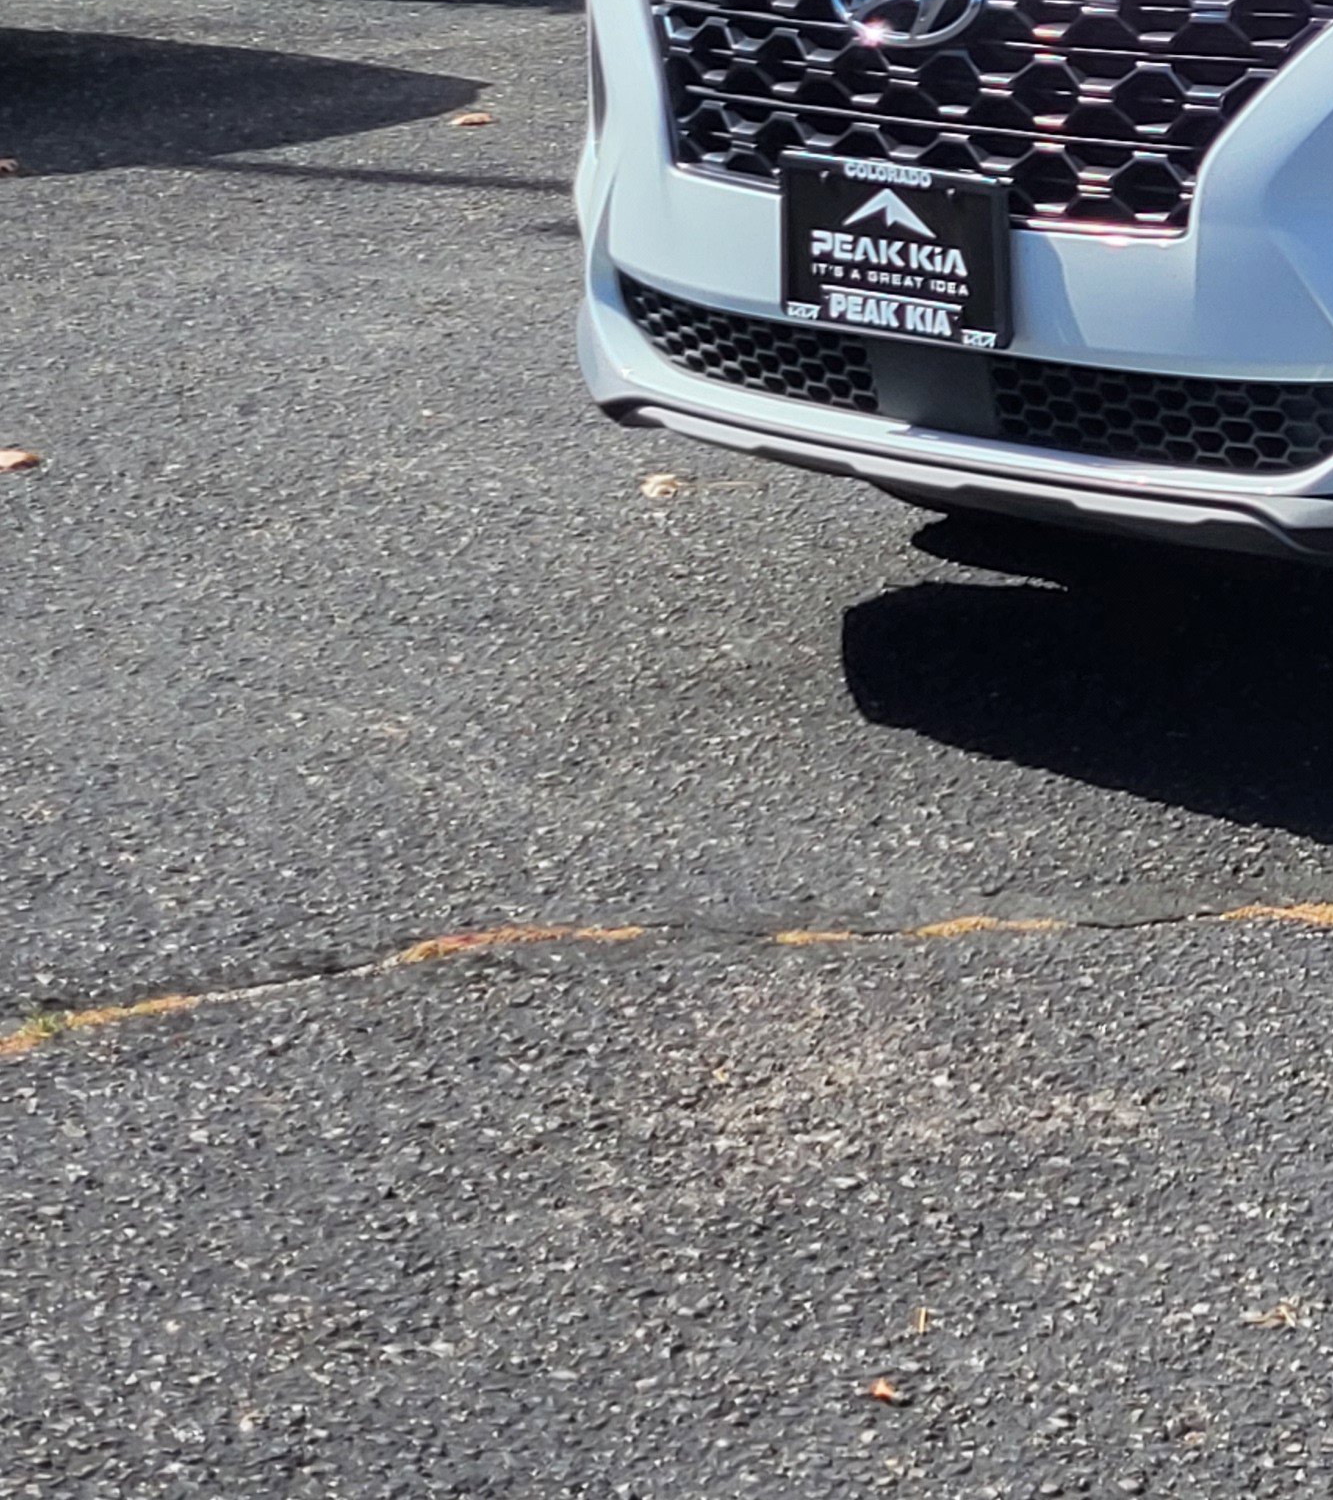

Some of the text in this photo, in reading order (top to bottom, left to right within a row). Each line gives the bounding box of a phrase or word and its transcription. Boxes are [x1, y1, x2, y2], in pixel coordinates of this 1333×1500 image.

[843, 161, 933, 188] COLORADO
[811, 229, 906, 268] PEAK
[811, 262, 970, 296] IT'S A GREAT IDEA
[829, 292, 953, 337] PEAK KIA
